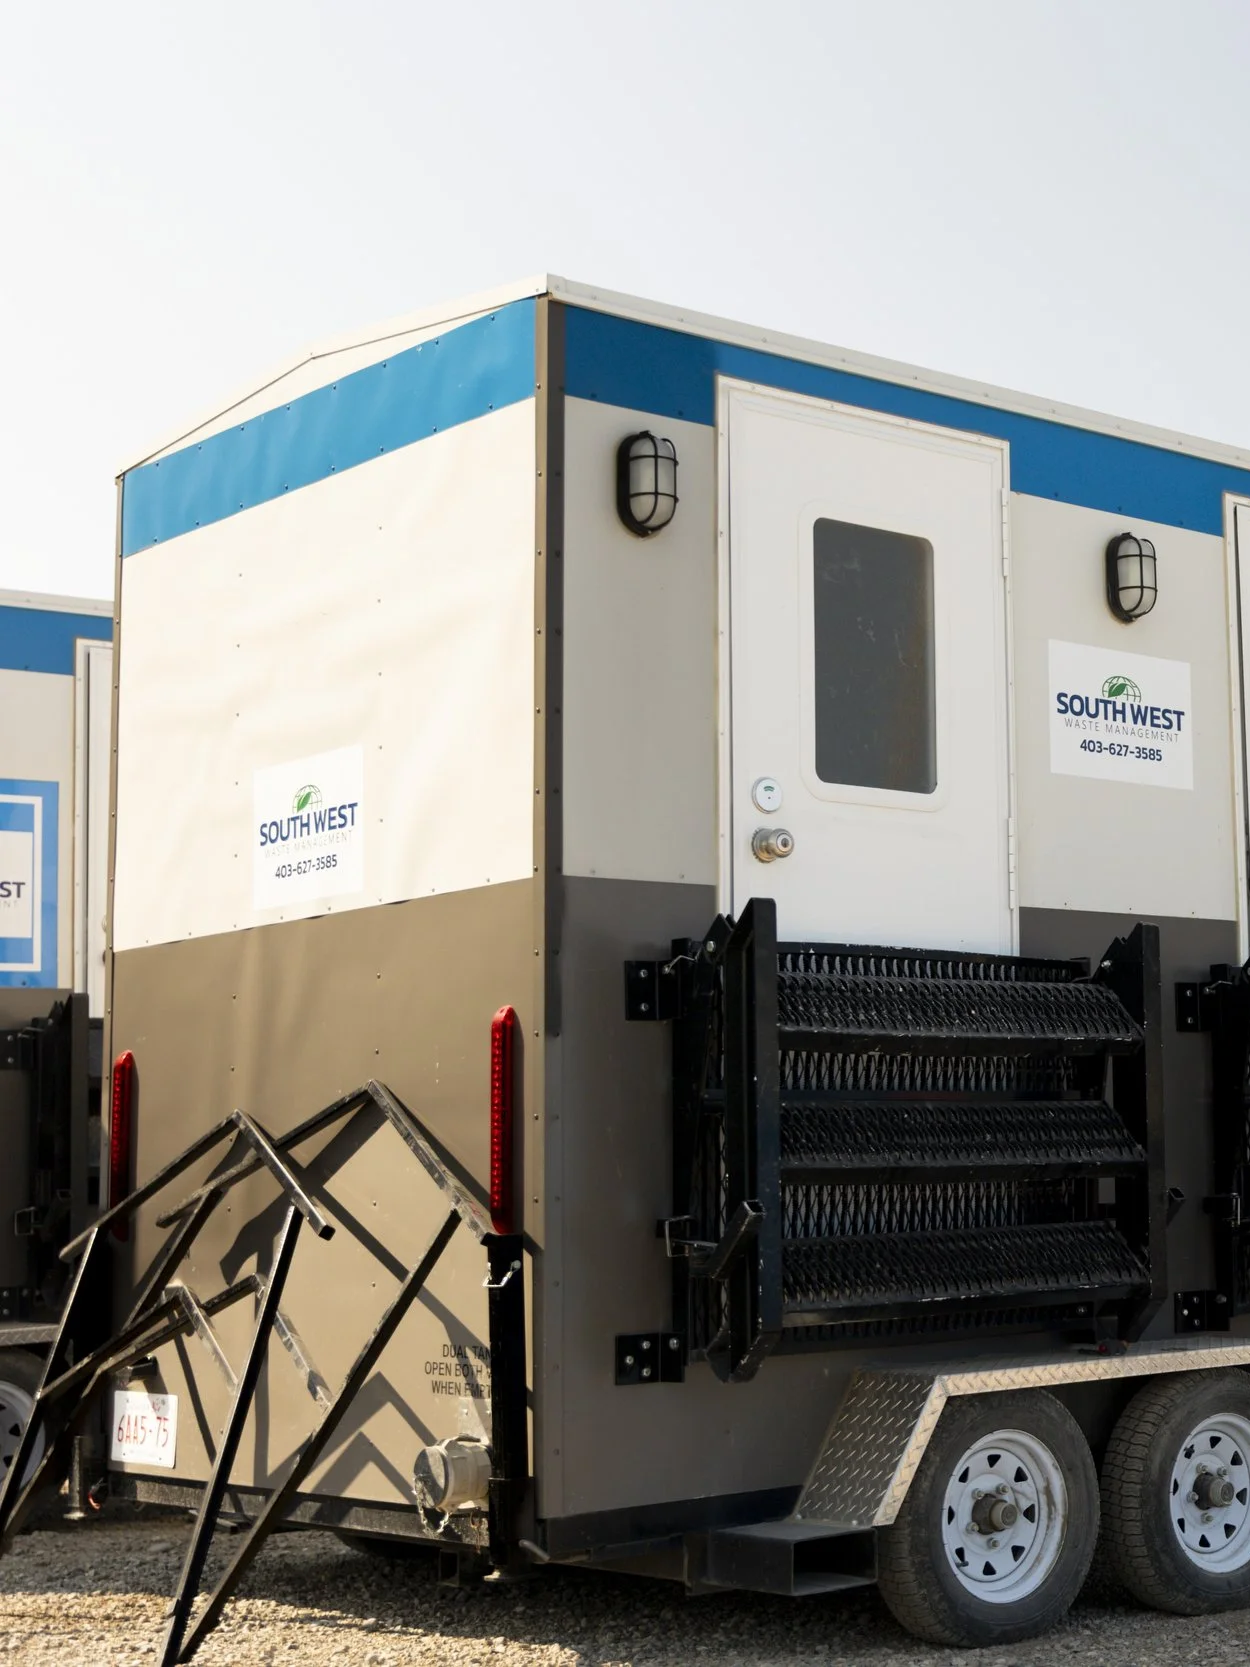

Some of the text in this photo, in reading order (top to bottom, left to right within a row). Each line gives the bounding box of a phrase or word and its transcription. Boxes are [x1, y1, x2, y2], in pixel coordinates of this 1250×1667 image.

[1056, 692, 1185, 732] SOUTH WEST
[1064, 717, 1179, 743] WASTE MANAGEMENT
[1080, 739, 1163, 762] 403-627-3585
[260, 802, 358, 846] SOUTH WEST
[275, 854, 338, 879] 403-627-3585
[442, 1344, 469, 1359] DUAL
[425, 1361, 452, 1377] OPEN
[455, 1364, 482, 1378] BOTH
[431, 1380, 462, 1396] WHEN
[117, 1414, 169, 1448] 6AA5-75
